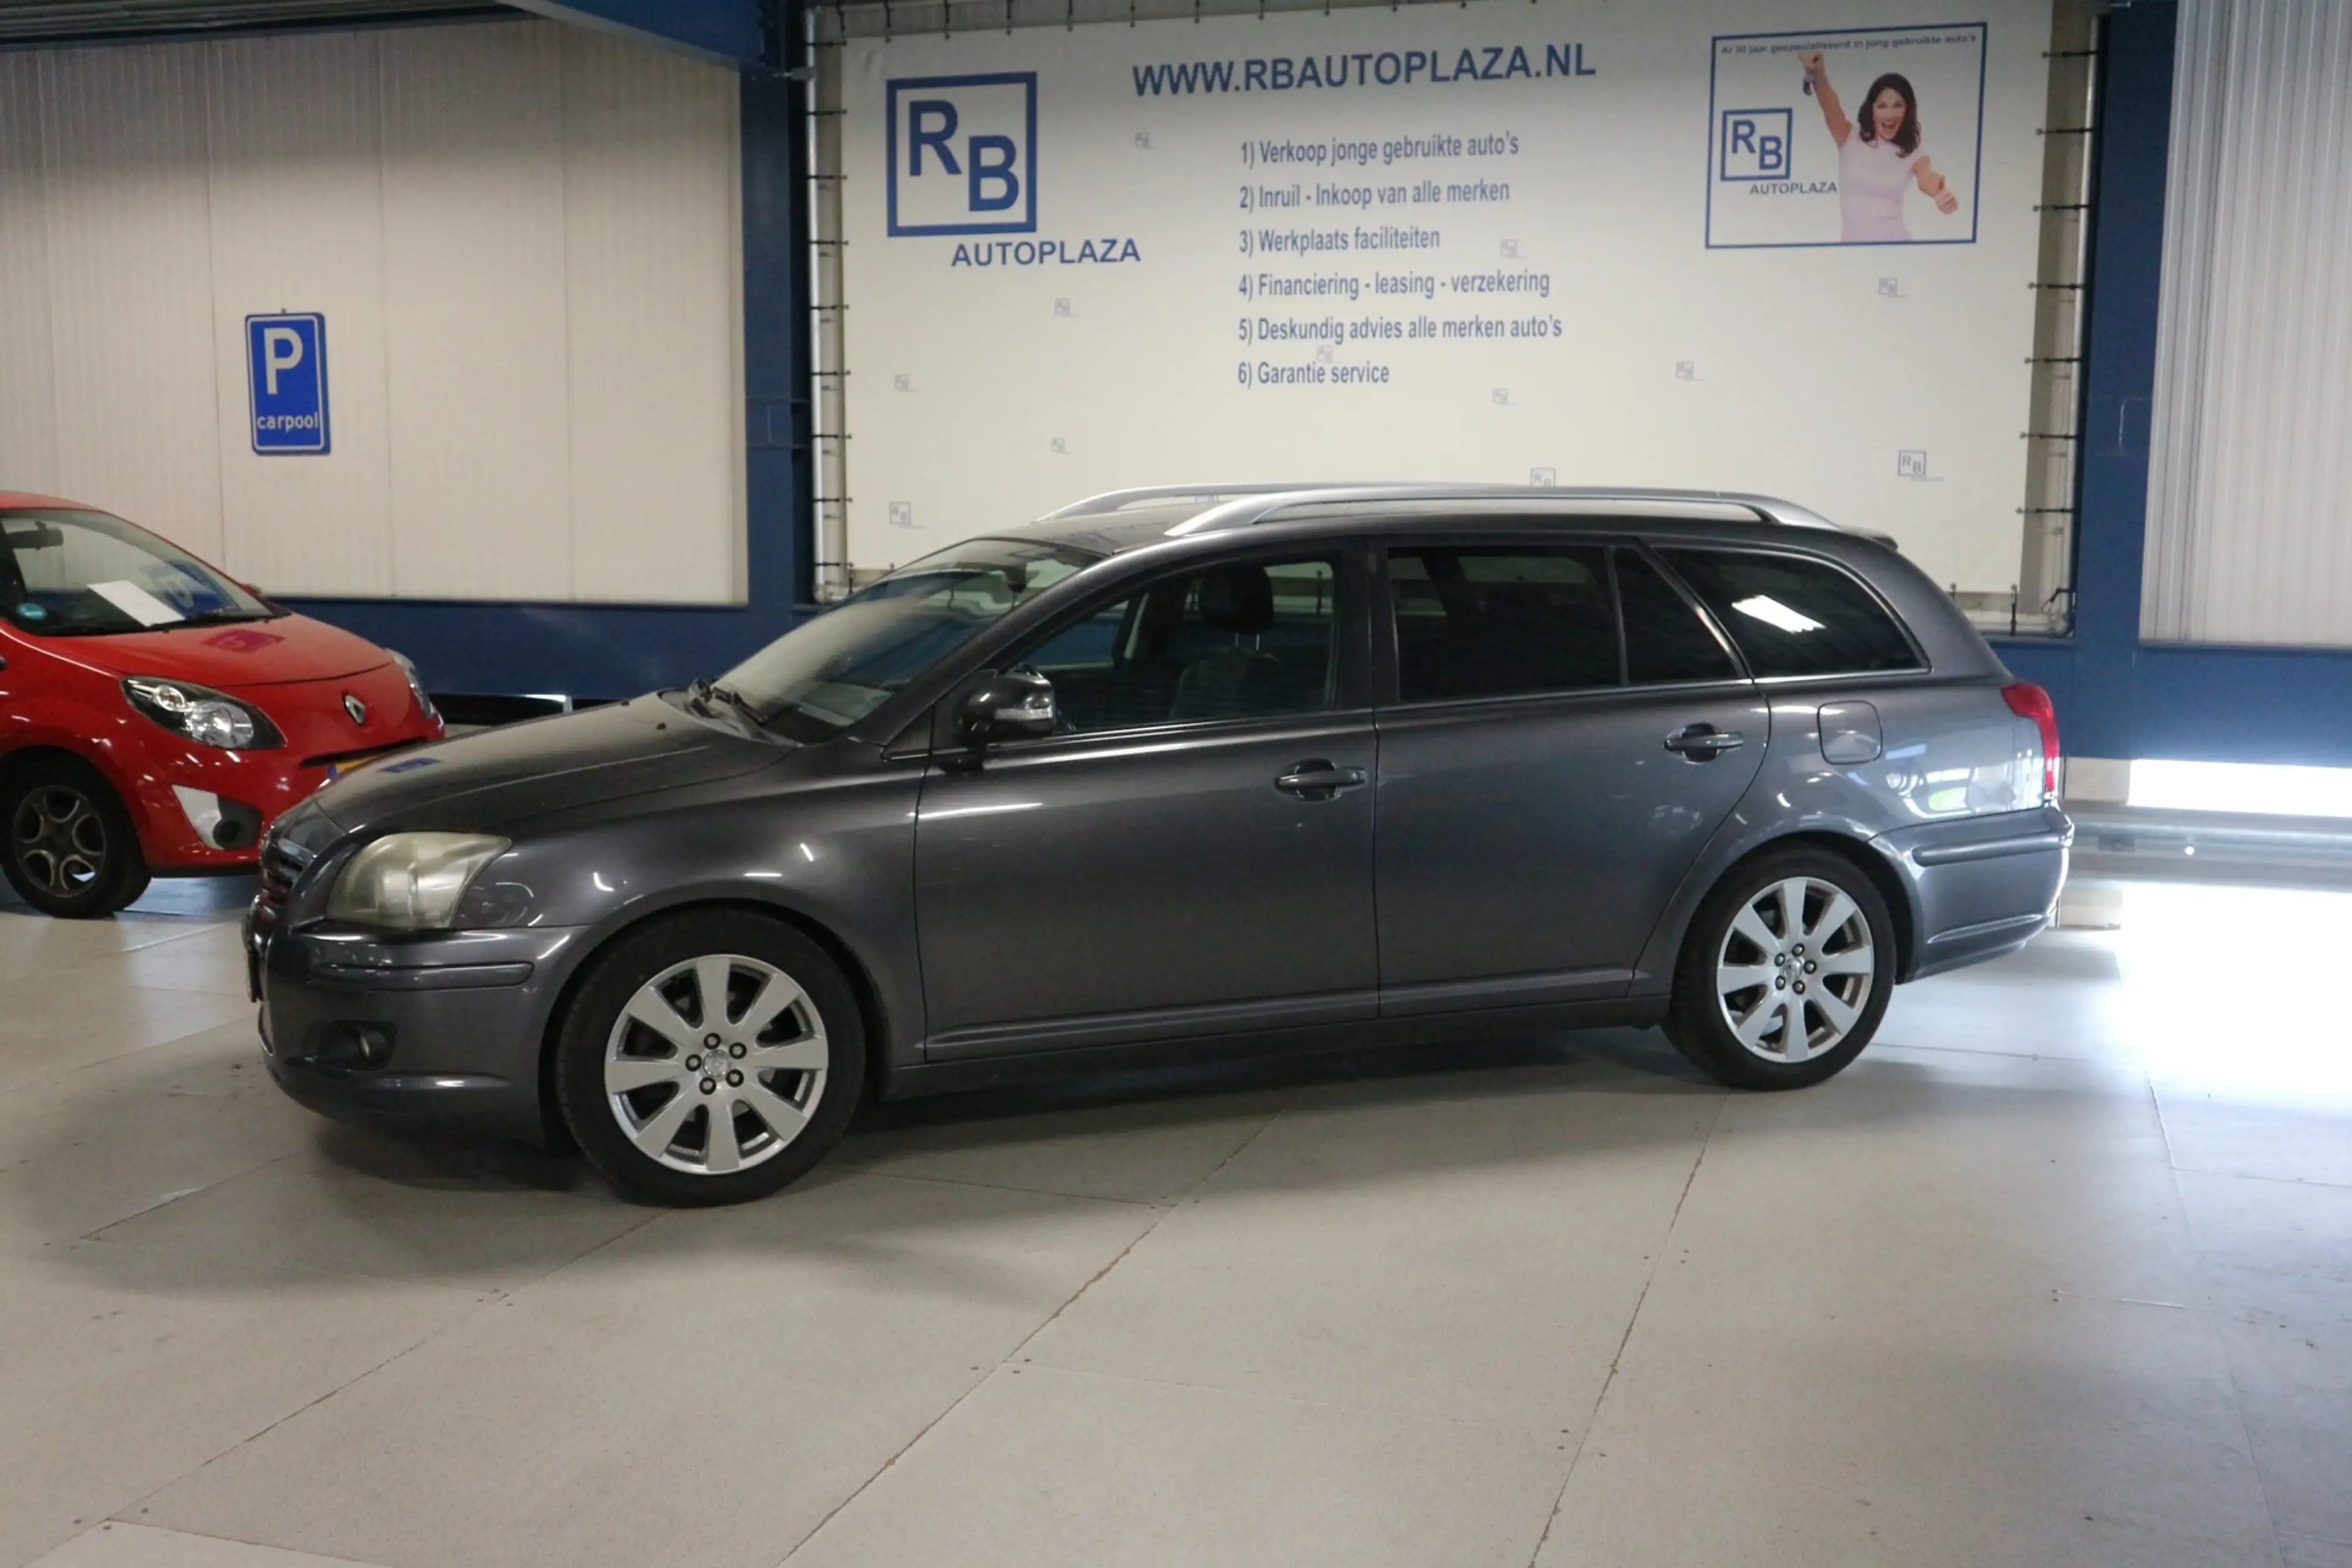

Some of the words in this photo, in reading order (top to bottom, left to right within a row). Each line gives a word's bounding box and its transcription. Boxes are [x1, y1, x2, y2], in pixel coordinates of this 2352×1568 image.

[1133, 43, 1596, 97] WWW.RBAUTOPLAZA.NL
[909, 99, 1019, 212] RB
[1241, 141, 1254, 169] 1)
[1260, 140, 1327, 167] Verkoop
[1330, 138, 1378, 167] jonge
[1383, 134, 1462, 165] gebruikte
[1467, 130, 1519, 156] auto's
[1732, 119, 1783, 170] RB
[1239, 185, 1254, 214] 2)
[1259, 184, 1300, 208] Inruil
[1316, 183, 1372, 209] Inkoop
[1378, 186, 1407, 205] van
[1412, 180, 1441, 203] alle
[1447, 178, 1510, 203] merken
[1749, 182, 1837, 195] AUTOPLAZA
[951, 238, 1141, 267] AUTOPLAZA
[1239, 230, 1254, 257] 3)
[1259, 228, 1349, 257] Werkplaats
[1354, 226, 1441, 250] faciliteiten
[1238, 273, 1253, 301] 4)
[1259, 273, 1359, 301] Financiering
[1375, 271, 1434, 300] leasing
[1451, 269, 1550, 298] verzekering
[1238, 317, 1253, 346] 5)
[1258, 316, 1344, 345] Deskundig
[1349, 316, 1403, 339] advies
[1408, 316, 1437, 339] alle
[1442, 315, 1505, 338] merken
[1510, 314, 1562, 337] auto's
[264, 327, 304, 395] P
[1238, 361, 1253, 390] 6)
[1257, 361, 1325, 385] Garantie
[1331, 361, 1390, 384] service
[257, 411, 318, 433] carpool
